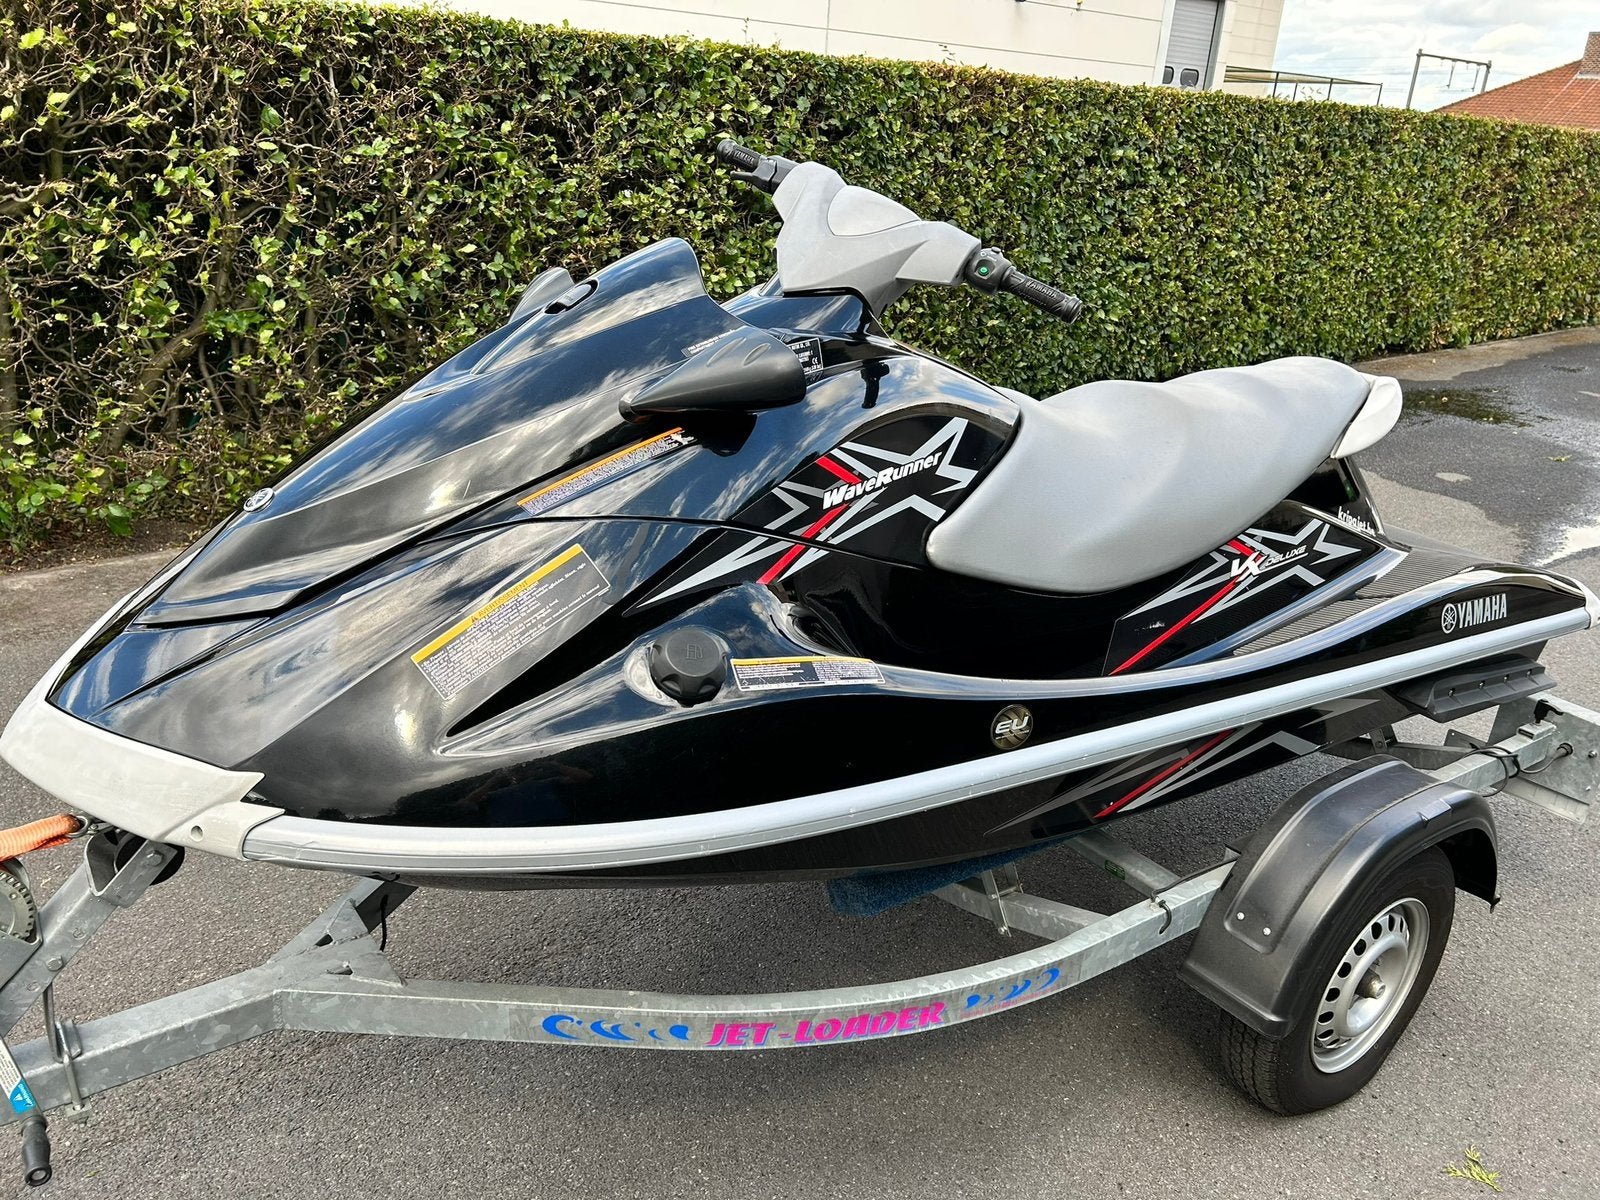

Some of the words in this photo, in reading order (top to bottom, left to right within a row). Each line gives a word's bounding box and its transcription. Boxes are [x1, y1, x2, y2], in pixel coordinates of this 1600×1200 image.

[1025, 280, 1057, 299] YAMAHA
[822, 452, 942, 510] WaveRunner
[1230, 550, 1267, 583] VX
[1265, 545, 1307, 566] DELUXE
[1458, 593, 1507, 628] YAMAHA
